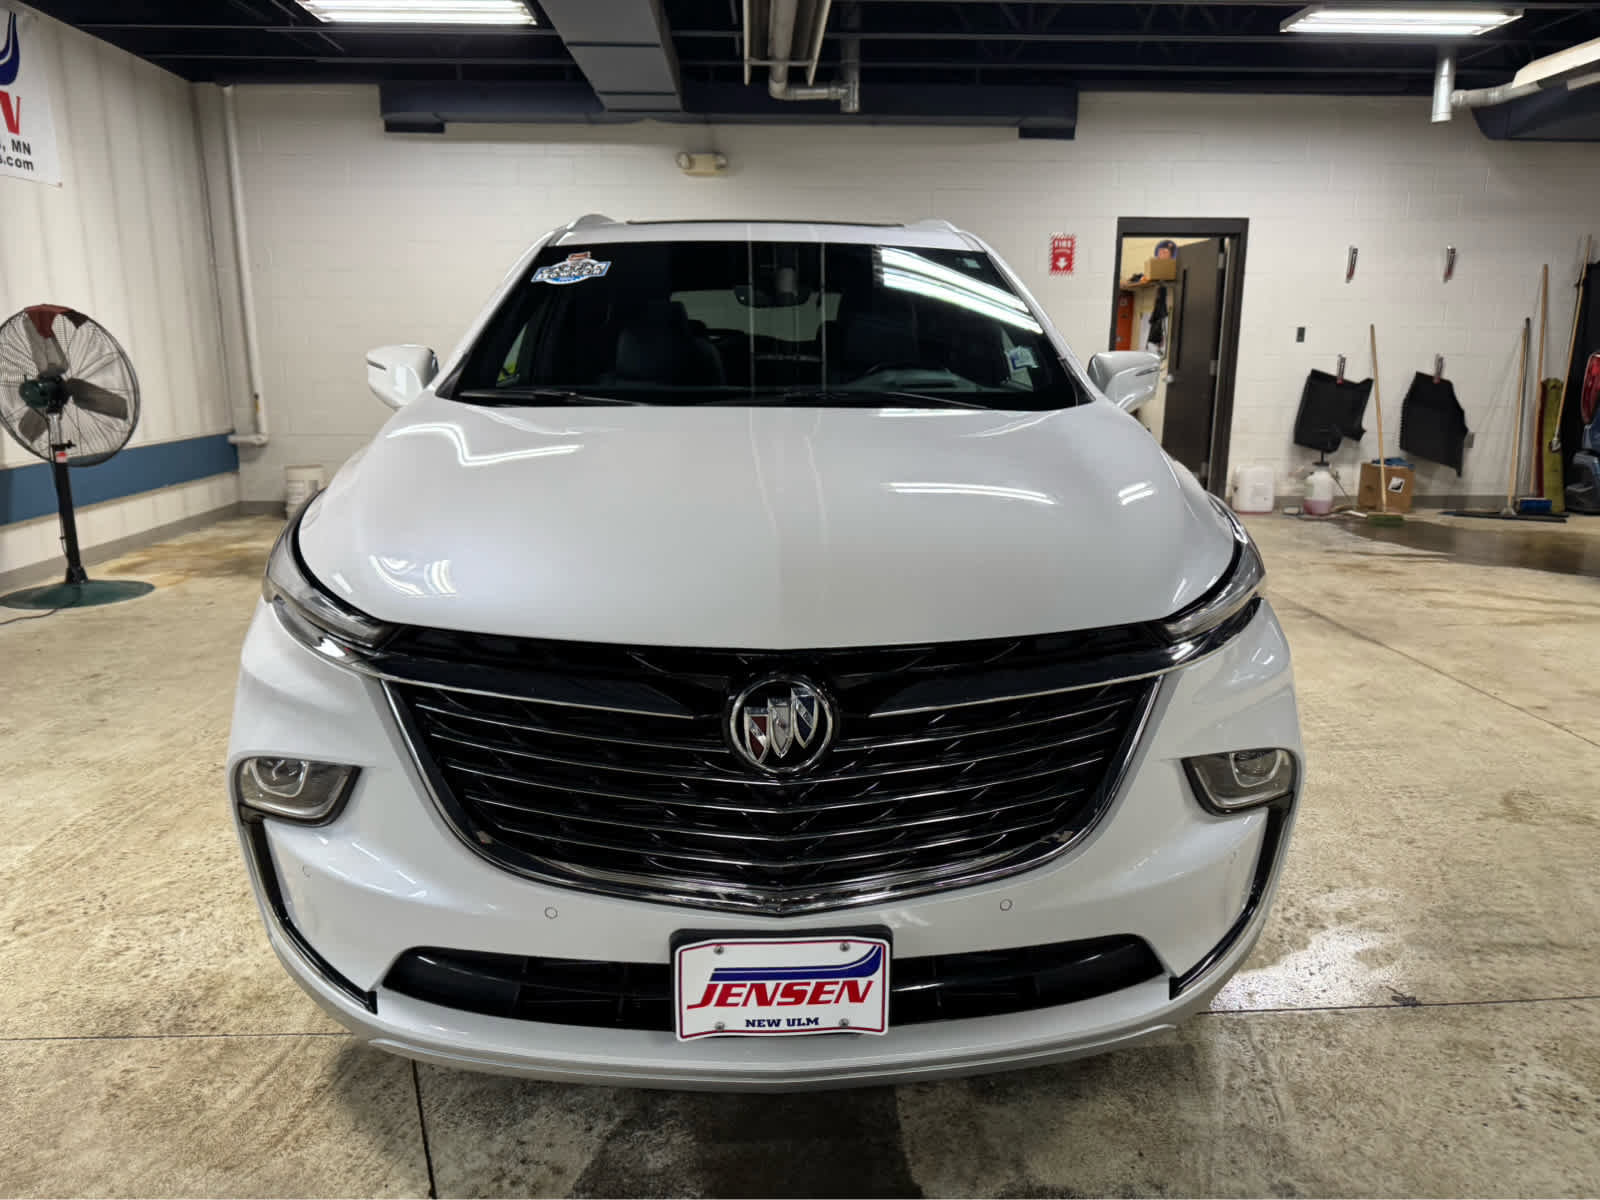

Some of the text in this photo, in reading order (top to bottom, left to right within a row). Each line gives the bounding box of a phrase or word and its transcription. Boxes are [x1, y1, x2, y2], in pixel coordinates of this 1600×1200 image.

[11, 139, 31, 156] MN
[687, 980, 873, 1010] JENSEN
[745, 1017, 820, 1028] NEW ULM
